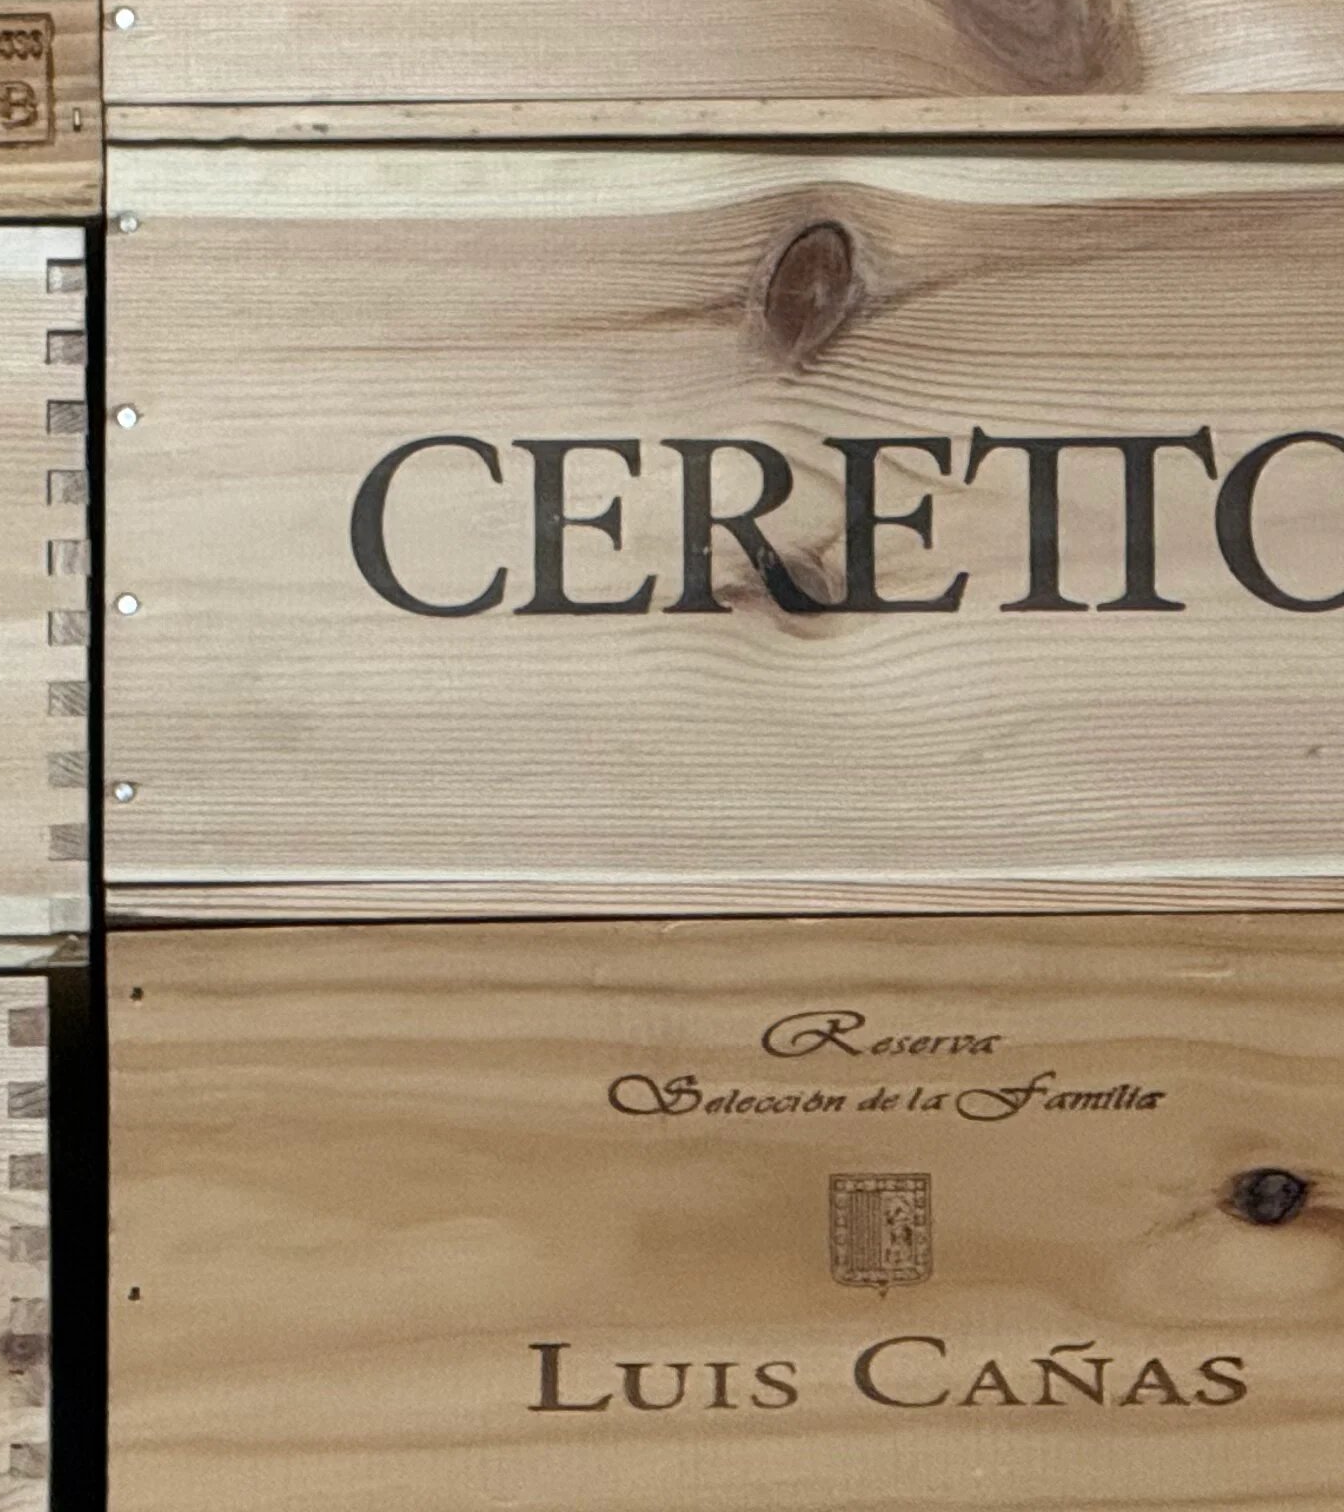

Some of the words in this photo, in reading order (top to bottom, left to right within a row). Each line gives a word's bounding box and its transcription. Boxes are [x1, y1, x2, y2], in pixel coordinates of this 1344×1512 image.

[760, 1009, 1005, 1059] Reserva
[607, 1073, 848, 1118] Selección
[856, 1086, 901, 1112] de
[906, 1086, 952, 1112] la
[955, 1071, 1168, 1123] Familia
[527, 1341, 800, 1413] LUIS
[853, 1334, 1249, 1409] CAÑAS
